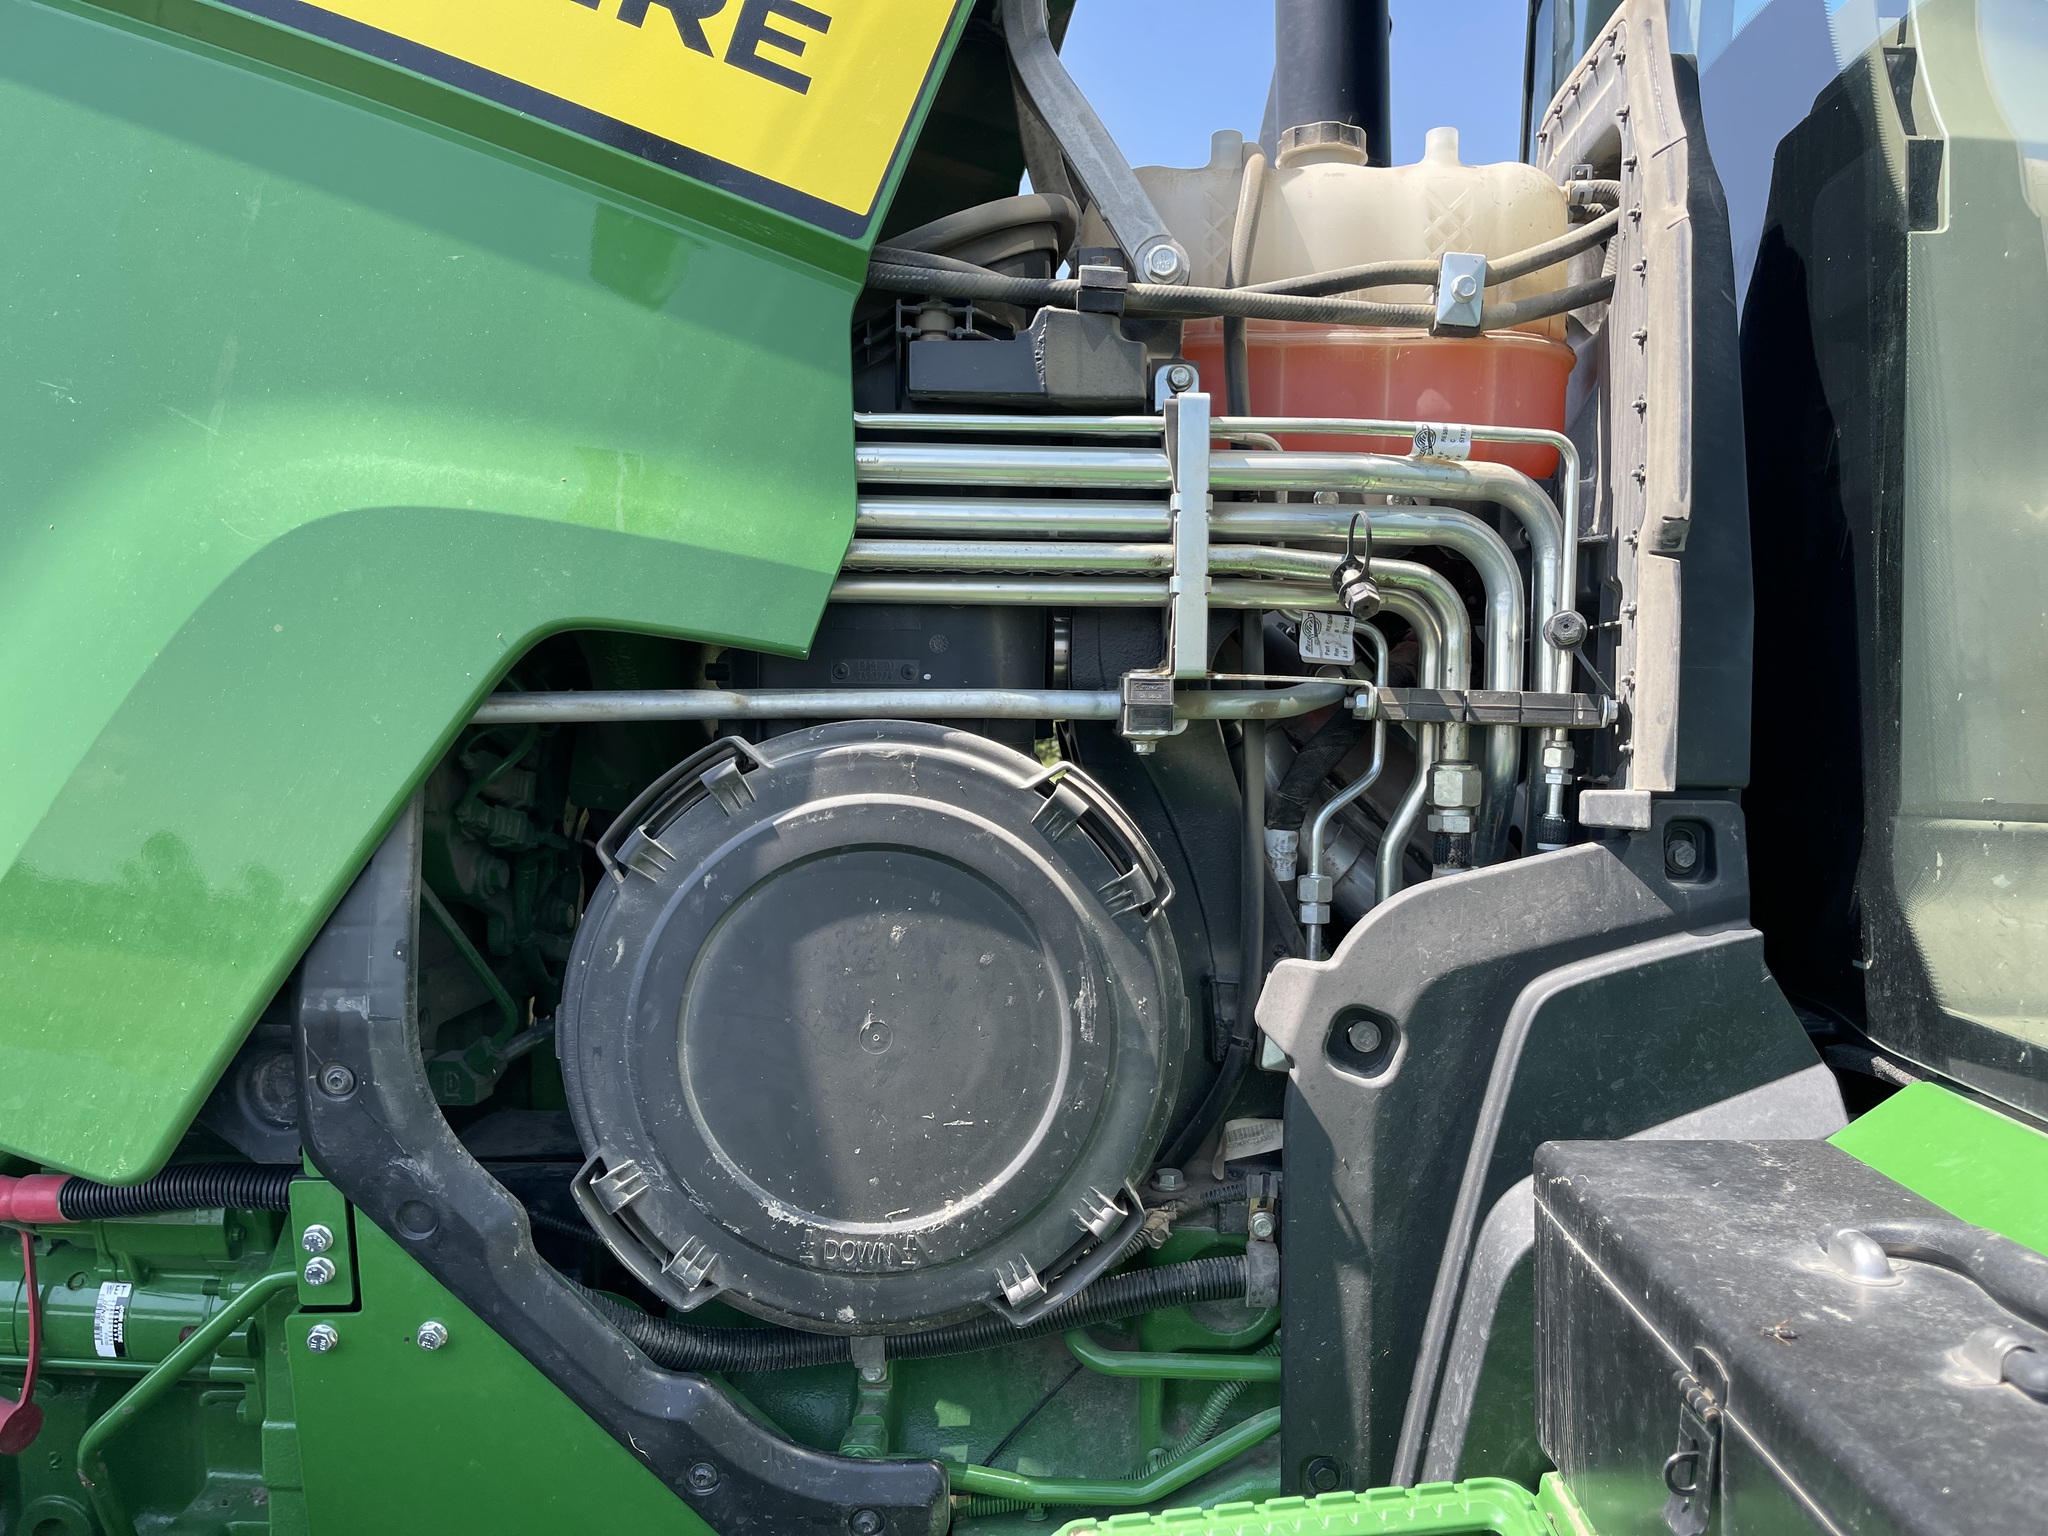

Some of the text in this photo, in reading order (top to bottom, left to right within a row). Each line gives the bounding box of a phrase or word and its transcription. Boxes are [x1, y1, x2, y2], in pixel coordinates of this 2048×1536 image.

[824, 1239, 894, 1266] DOWN
[106, 1284, 127, 1295] WET
[117, 1305, 125, 1322] JOHN
